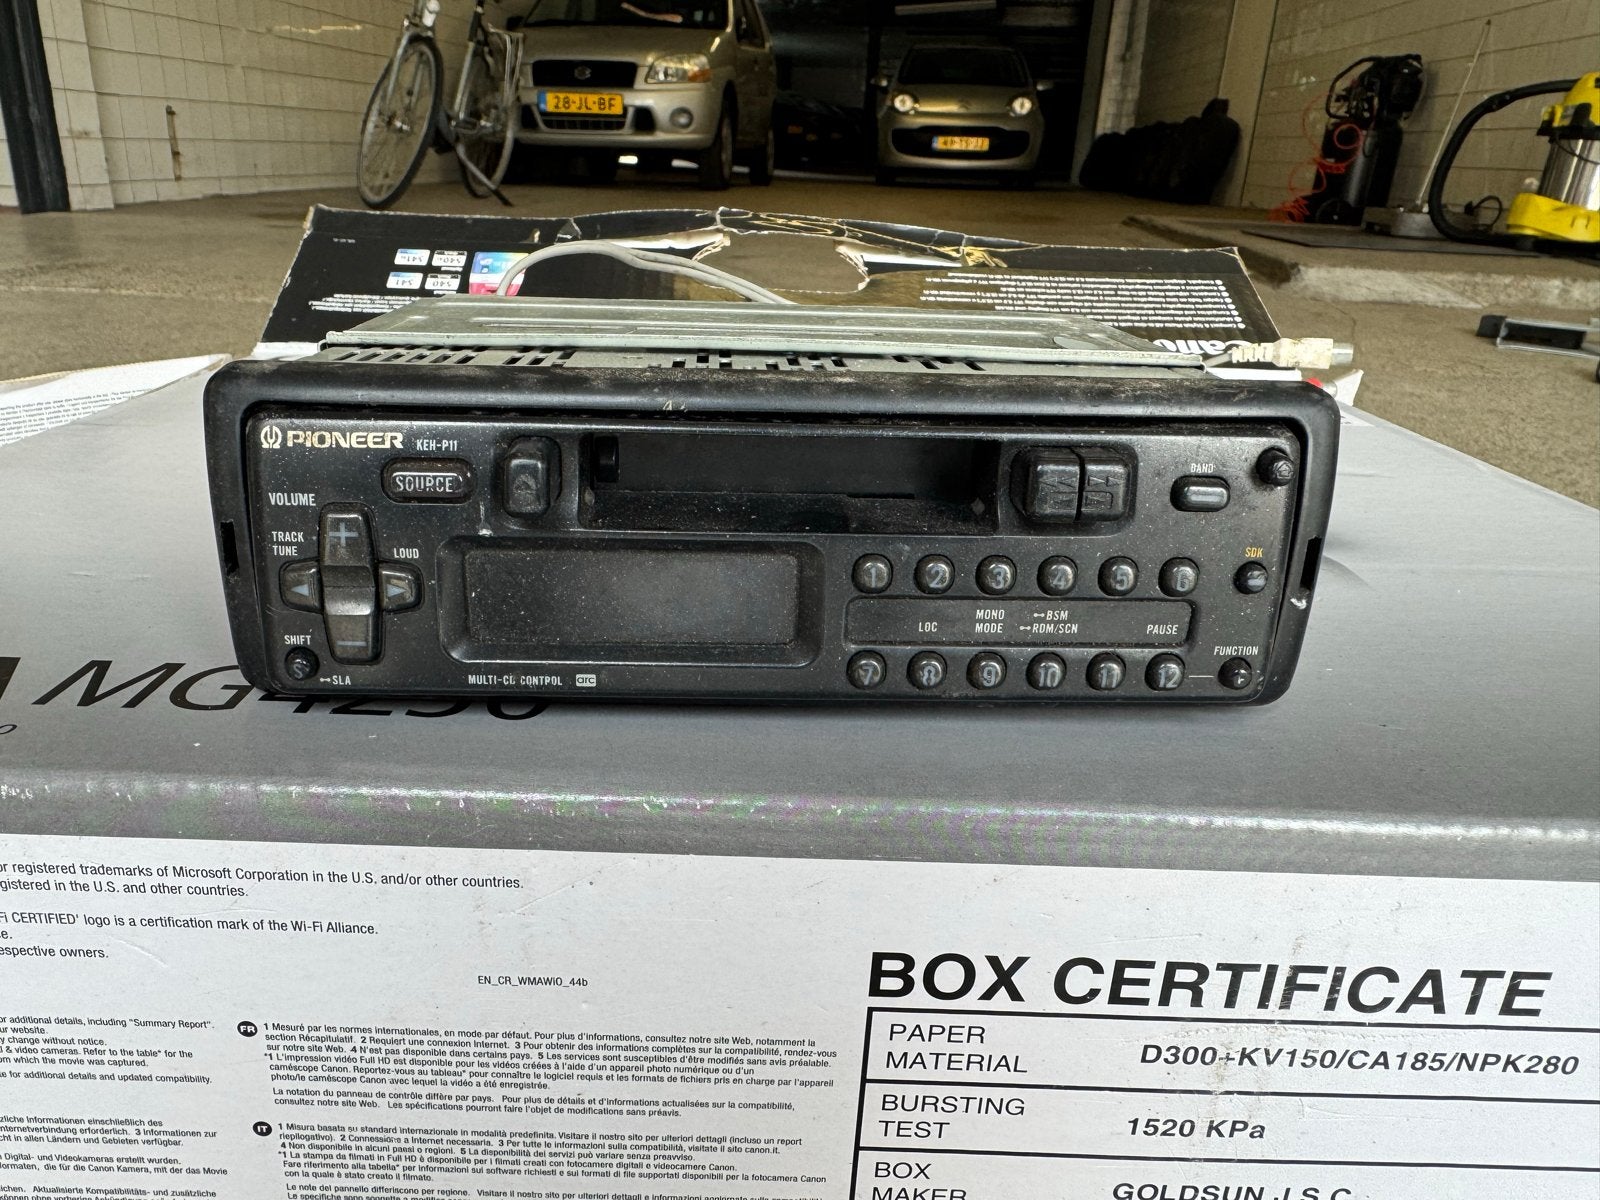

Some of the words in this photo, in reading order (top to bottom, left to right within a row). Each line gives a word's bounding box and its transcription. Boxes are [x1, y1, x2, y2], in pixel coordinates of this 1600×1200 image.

[552, 94, 617, 111] 28-JL-BF
[287, 431, 403, 449] PIONEER
[416, 439, 458, 452] KEH-P11
[395, 476, 453, 493] SOURCE
[268, 492, 316, 507] VOLUME
[271, 531, 304, 543] TRACK
[272, 545, 298, 556] TUNE
[393, 547, 420, 559] LOUD
[1245, 546, 1263, 558] SDK
[869, 566, 878, 588] 1
[930, 566, 943, 588] 2
[992, 567, 1006, 589] 3
[1053, 568, 1068, 590] 4
[1115, 569, 1129, 590] 5
[1176, 570, 1189, 592] 6
[975, 609, 1005, 620] MONO
[1046, 610, 1069, 621] BSM
[918, 622, 938, 632] LOC
[975, 623, 1003, 633] MODE
[1032, 623, 1078, 634] RDM/SCN
[1146, 624, 1179, 635] PAUSE
[284, 634, 312, 645] SHIFT
[1213, 646, 1259, 656] FUNCTION
[332, 675, 351, 686] SLA
[576, 675, 596, 686] arc
[861, 665, 874, 685] 7
[922, 665, 937, 686] 8
[982, 666, 996, 687] 9
[1038, 666, 1060, 688] 10
[1100, 667, 1118, 688] 11
[1159, 668, 1180, 688] 12
[11, 861, 77, 876] registered
[78, 863, 153, 877] trademarks
[156, 865, 168, 877] of
[172, 865, 232, 879] Microsoft
[234, 867, 309, 882] Corporation
[312, 870, 324, 882] in
[326, 870, 348, 883] the
[351, 871, 377, 884] U.S.
[380, 872, 422, 885] and/or
[425, 873, 458, 887] other
[461, 876, 524, 889] countries.
[0, 878, 51, 892] gistered
[53, 879, 67, 891] in
[68, 880, 90, 892] the
[92, 880, 120, 893] U.S.
[122, 881, 147, 894] and
[149, 882, 183, 895] other
[186, 884, 248, 897] countries.
[83, 913, 111, 928] logo
[113, 914, 125, 926] is
[128, 917, 137, 927] a
[139, 916, 213, 929] certification
[216, 918, 250, 930] mark
[252, 918, 264, 931] of
[267, 919, 288, 932] the
[289, 919, 323, 933] Wi-Fi
[325, 921, 378, 935] Alliance.
[59, 948, 109, 958] owners.
[868, 951, 1031, 1003] BOX
[1053, 957, 1553, 1017] CERTIFICATE
[8, 1015, 52, 1024] additional
[53, 1016, 86, 1027] details,
[87, 1017, 127, 1028] including
[128, 1018, 176, 1029] "Summary
[177, 1019, 215, 1030] Report".
[9, 1025, 49, 1034] website.
[239, 1023, 257, 1035] FR
[7, 1035, 40, 1046] change
[41, 1036, 76, 1045] without
[77, 1037, 107, 1046] notice.
[263, 1022, 269, 1031] 1
[271, 1022, 305, 1032] Mesuré
[307, 1025, 322, 1034] par
[323, 1024, 338, 1033] les
[339, 1026, 373, 1034] normes
[374, 1025, 442, 1037] internationales,
[443, 1029, 455, 1037] en
[457, 1029, 482, 1038] mode
[484, 1031, 500, 1040] par
[501, 1030, 532, 1040] défaut.
[534, 1031, 555, 1040] Pour
[556, 1031, 575, 1041] plus
[577, 1032, 643, 1043] d'informations,
[644, 1034, 687, 1043] consultez
[688, 1035, 712, 1044] notre
[713, 1036, 730, 1045] site
[731, 1036, 753, 1046] Web,
[755, 1037, 806, 1047] notamment
[807, 1038, 816, 1047] la
[889, 1023, 986, 1044] PAPER
[5, 1045, 13, 1054] &
[13, 1045, 39, 1054] video
[40, 1047, 81, 1055] cameras.
[82, 1047, 106, 1056] Refer
[108, 1048, 118, 1056] to
[119, 1048, 134, 1057] the
[163, 1049, 177, 1058] for
[178, 1049, 193, 1058] the
[1140, 1044, 1580, 1075] D300+KV150/CA185/NPK280
[12, 1055, 40, 1064] which
[41, 1056, 56, 1065] the
[58, 1057, 85, 1065] movie
[86, 1058, 106, 1066] was
[106, 1058, 149, 1068] captured.
[885, 1051, 1028, 1074] MATERIAL
[8, 1070, 21, 1079] for
[23, 1070, 66, 1080] additional
[67, 1071, 97, 1080] details
[98, 1072, 116, 1081] and
[117, 1073, 153, 1082] updated
[154, 1074, 212, 1085] compatibility.
[881, 1094, 1026, 1116] BURSTING
[878, 1120, 950, 1139] TEST
[1127, 1117, 1196, 1138] 1520
[1205, 1119, 1266, 1140] KPa
[3, 1152, 34, 1162] Digital-
[36, 1153, 54, 1162] und
[53, 1153, 114, 1163] Videokameras
[115, 1155, 146, 1164] erstellt
[146, 1156, 182, 1165] wurden.
[874, 1161, 932, 1180] BOX
[872, 1187, 967, 1200] MAKER
[1112, 1182, 1264, 1200] GOLDSUN
